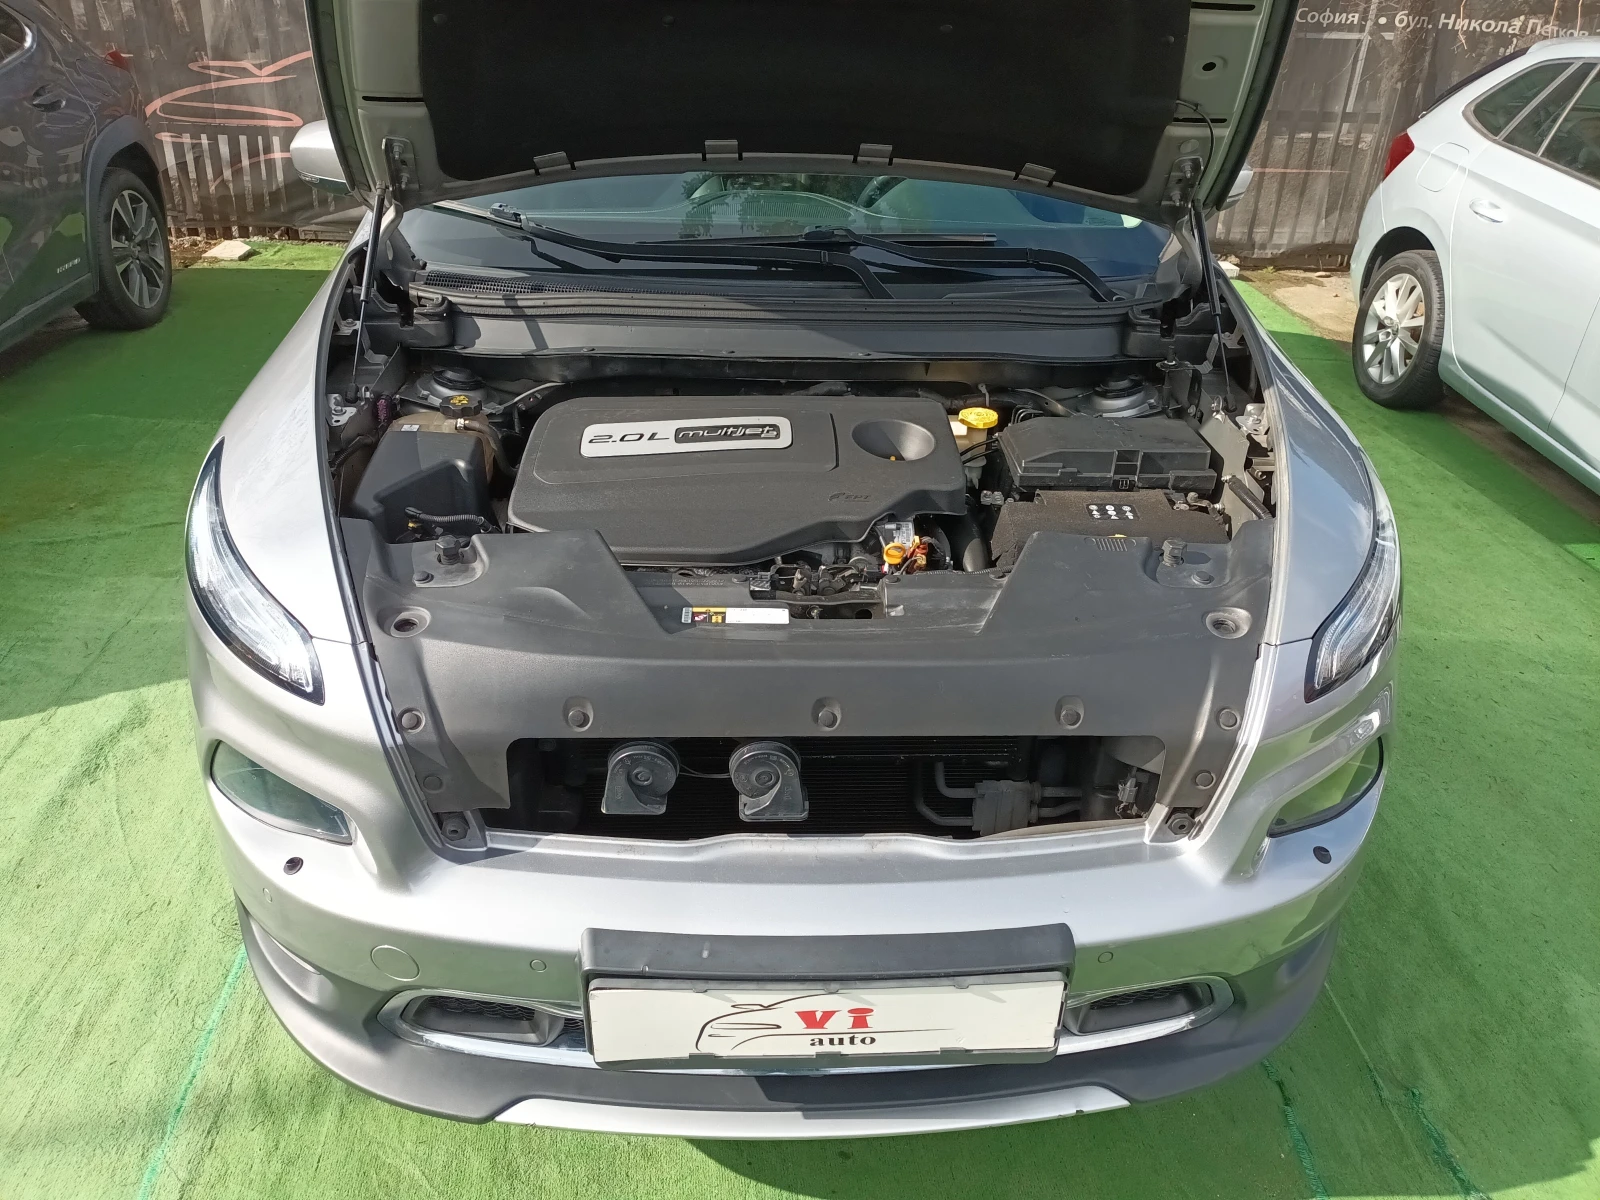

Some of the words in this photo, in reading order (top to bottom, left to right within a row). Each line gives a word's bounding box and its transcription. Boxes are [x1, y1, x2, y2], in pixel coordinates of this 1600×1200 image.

[1295, 7, 1359, 27] София
[1394, 10, 1433, 32] бул.
[1438, 13, 1520, 35] Никола
[809, 1034, 876, 1046] auto
